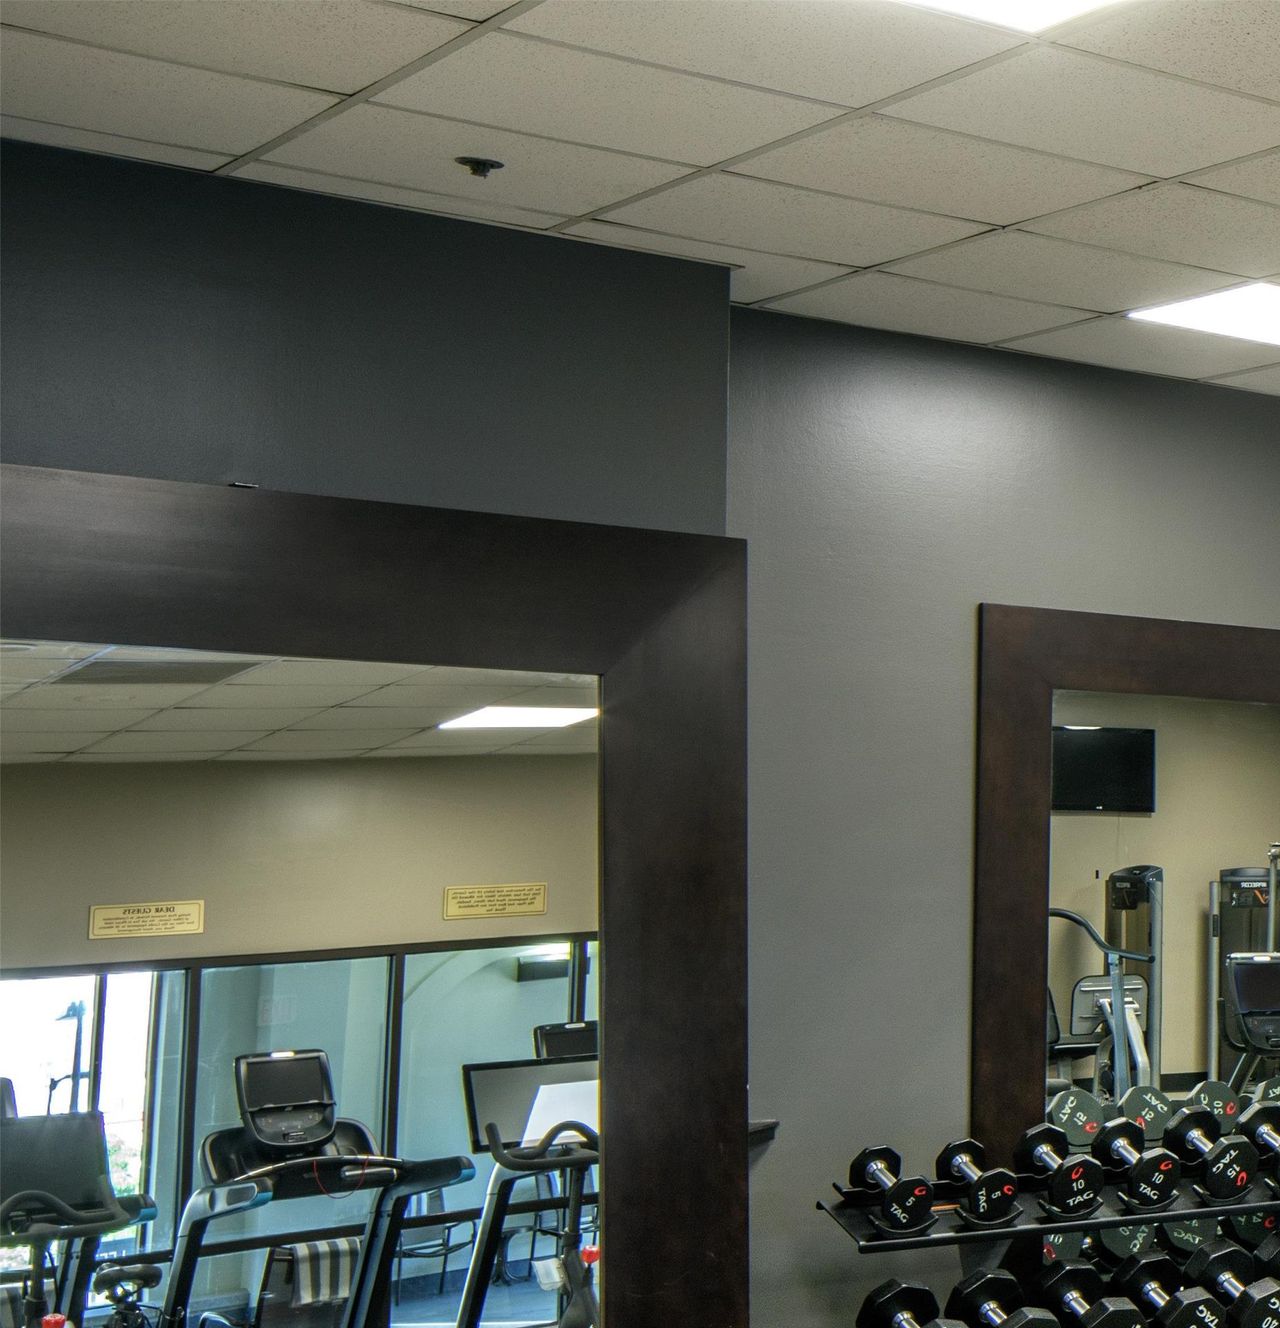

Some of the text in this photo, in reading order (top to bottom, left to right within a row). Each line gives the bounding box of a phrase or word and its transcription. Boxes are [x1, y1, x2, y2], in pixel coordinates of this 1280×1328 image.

[1213, 1150, 1238, 1174] TAG
[1152, 1172, 1163, 1183] 10
[1227, 1164, 1240, 1178] 15
[1072, 1179, 1085, 1191] 10
[1139, 1183, 1159, 1199] TAG
[906, 1197, 915, 1206] 5
[979, 1188, 987, 1212] TAG
[991, 1191, 1001, 1199] 5
[1066, 1191, 1094, 1206] TAG
[890, 1203, 909, 1224] TAG
